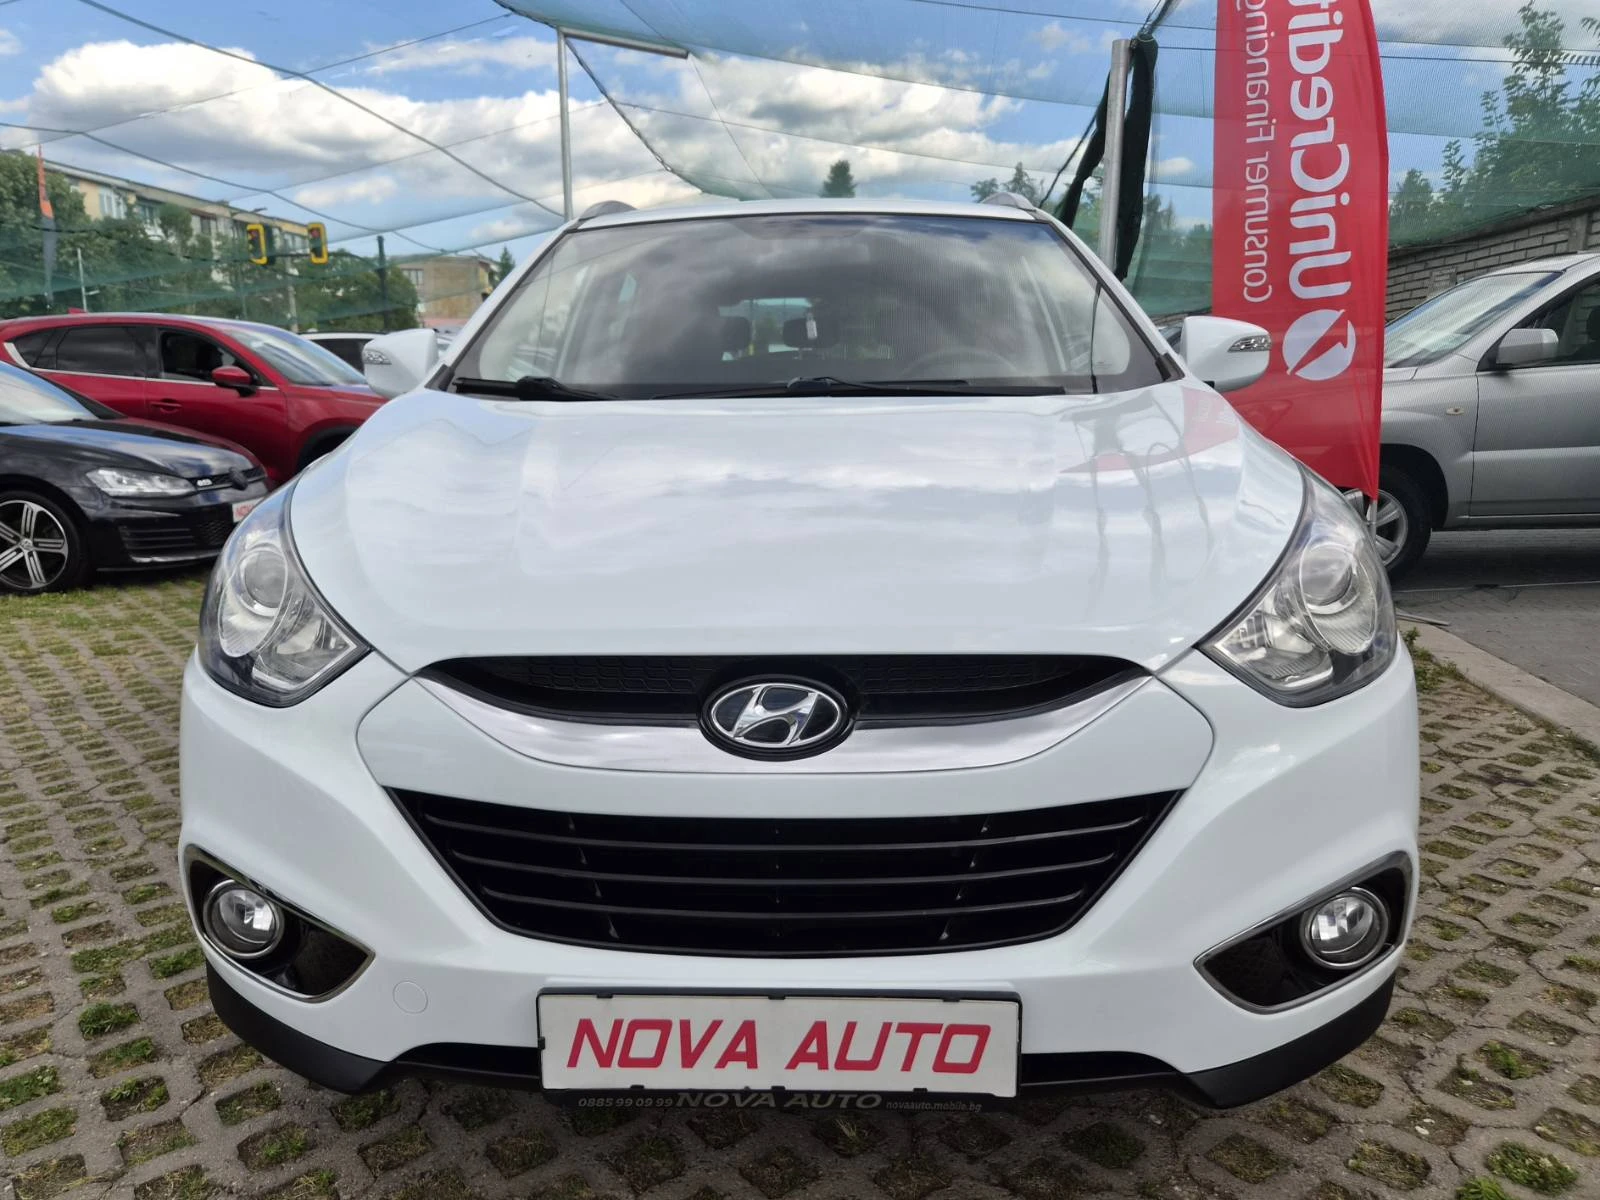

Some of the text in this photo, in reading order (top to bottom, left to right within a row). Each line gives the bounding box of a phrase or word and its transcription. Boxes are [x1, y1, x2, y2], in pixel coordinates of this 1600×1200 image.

[566, 1018, 992, 1074] NOVA AUTO
[578, 1097, 613, 1108] 0885
[615, 1097, 632, 1108] 99
[635, 1097, 651, 1108] 09
[655, 1097, 673, 1108] 99
[675, 1092, 777, 1108] NOVA
[783, 1093, 883, 1109] AUTO
